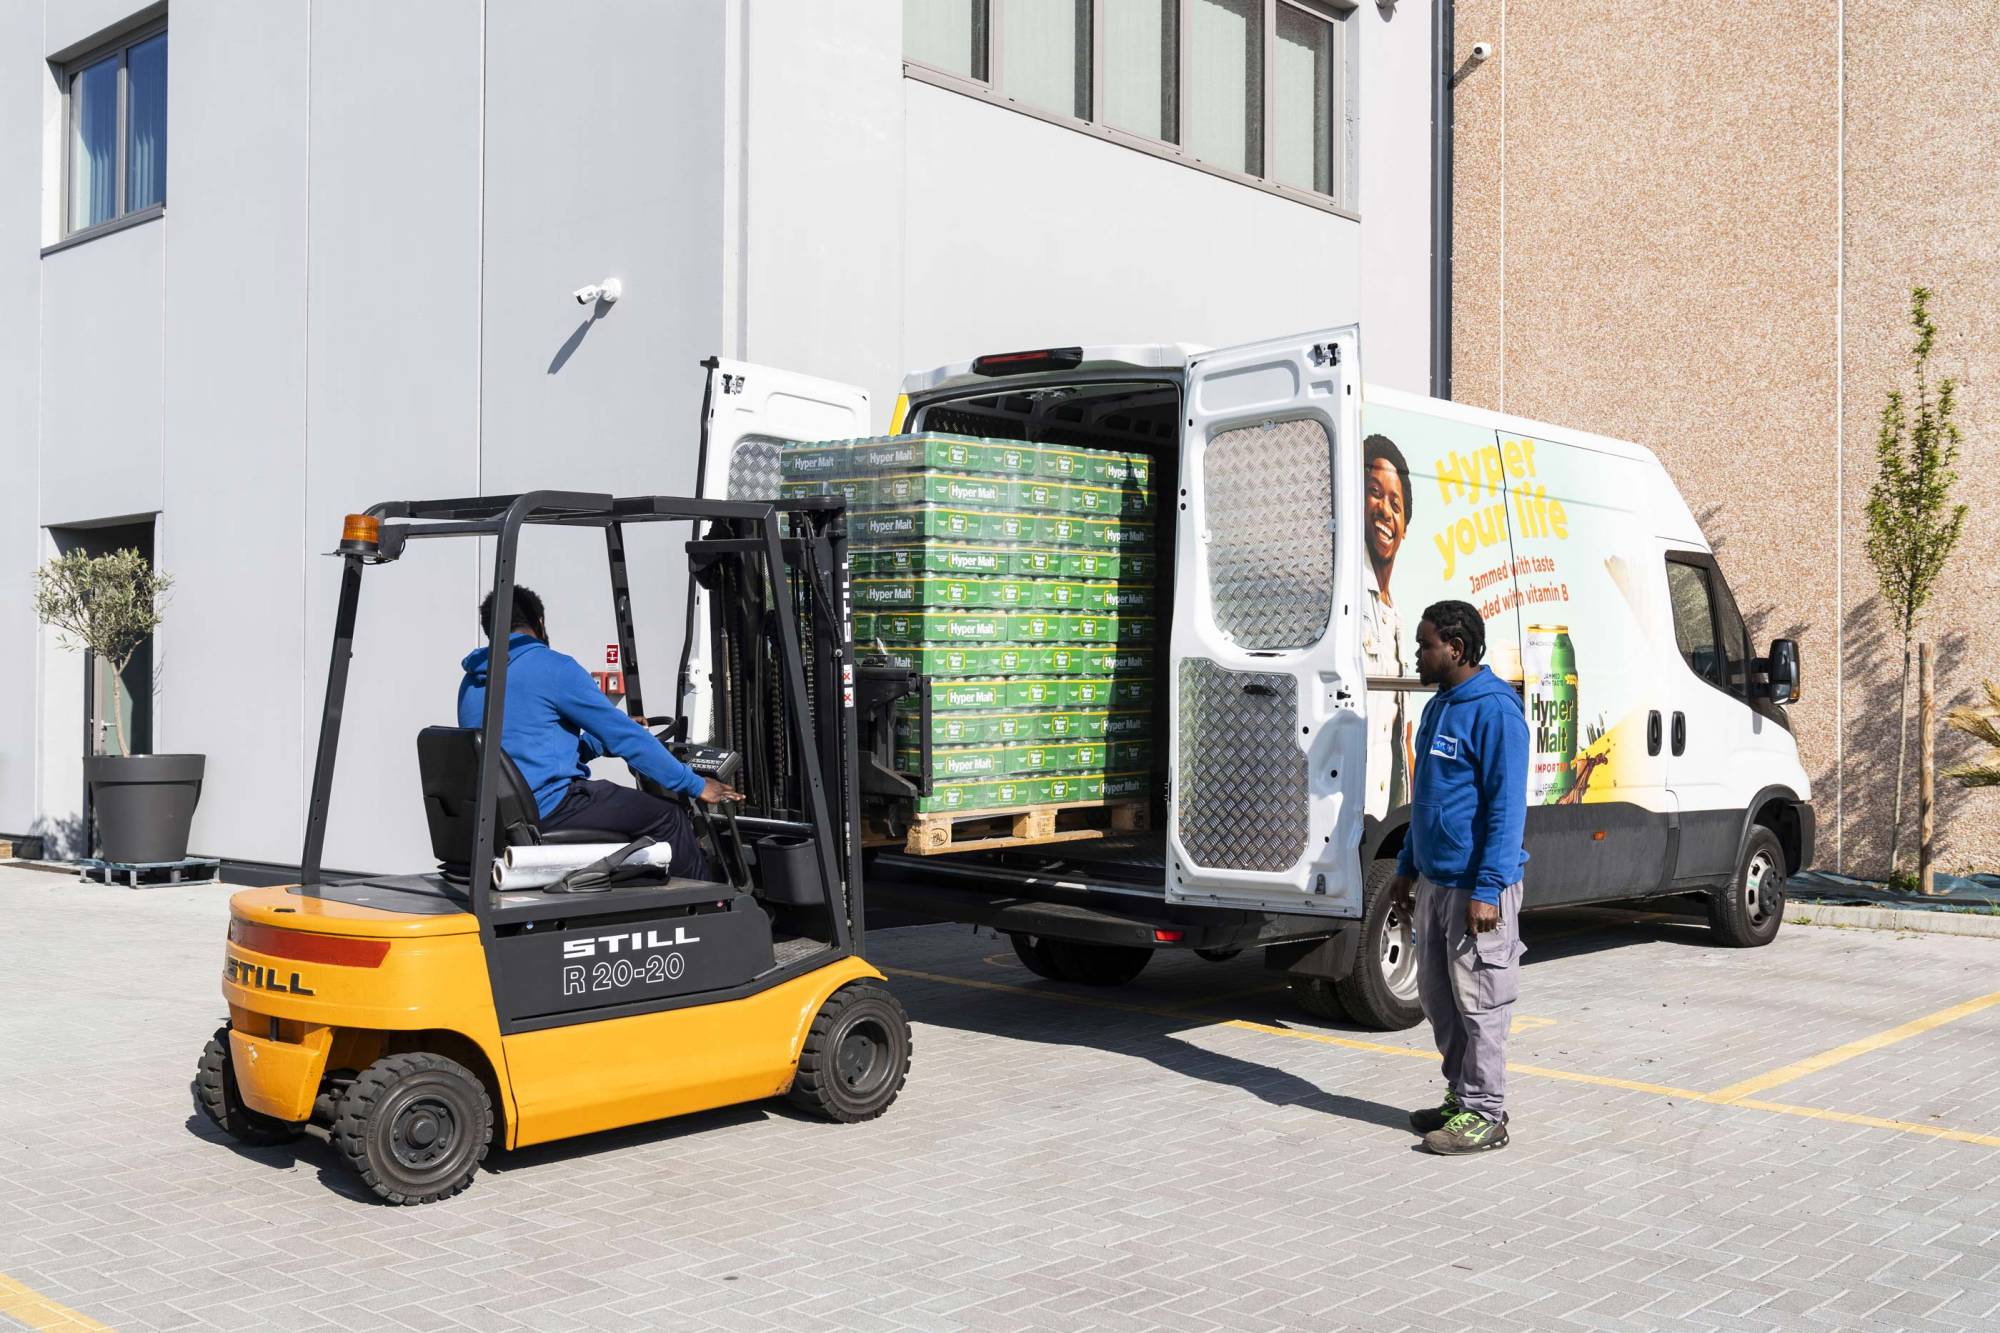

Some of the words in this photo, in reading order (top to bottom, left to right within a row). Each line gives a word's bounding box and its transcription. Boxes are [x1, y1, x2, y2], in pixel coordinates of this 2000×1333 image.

[795, 458, 817, 471] Hyper
[818, 457, 834, 467] Malt
[870, 452, 894, 465] Hyper
[895, 450, 913, 461] Malt
[1107, 465, 1129, 478] Hyper
[1435, 439, 1536, 505] Hyper
[951, 483, 976, 499] Hyper
[977, 486, 996, 499] Malt
[870, 519, 894, 532] Hyper
[895, 518, 912, 530] Malt
[1433, 503, 1507, 581] your
[1513, 480, 1569, 540] life
[1107, 529, 1128, 542] Hyper
[1129, 530, 1144, 541] Malt
[951, 553, 976, 567] Hyper
[977, 554, 996, 567] Malt
[1469, 560, 1508, 595] Jammed
[1509, 555, 1531, 577] with
[1532, 555, 1555, 573] taste
[869, 588, 894, 601] Hyper
[894, 587, 912, 599] Malt
[1106, 594, 1128, 606] Hyper
[1129, 594, 1144, 604] Malt
[1502, 588, 1525, 611] with
[1525, 581, 1560, 604] vitamin
[1561, 583, 1569, 602] B
[950, 622, 975, 635] Hyper
[976, 622, 994, 634] Malt
[894, 657, 911, 668] Malt
[1105, 656, 1126, 669] Hyper
[1127, 656, 1142, 667] Malt
[949, 691, 975, 705] Hyper
[976, 690, 994, 703] Malt
[1531, 693, 1573, 727] Hyper
[1103, 719, 1125, 731] Hyper
[1536, 727, 1567, 753] Malt
[948, 760, 973, 773] Hyper
[974, 758, 992, 770] Malt
[563, 927, 700, 959] STILL
[225, 956, 316, 996] STILL
[563, 965, 586, 995] R
[592, 952, 685, 991] 20-20
